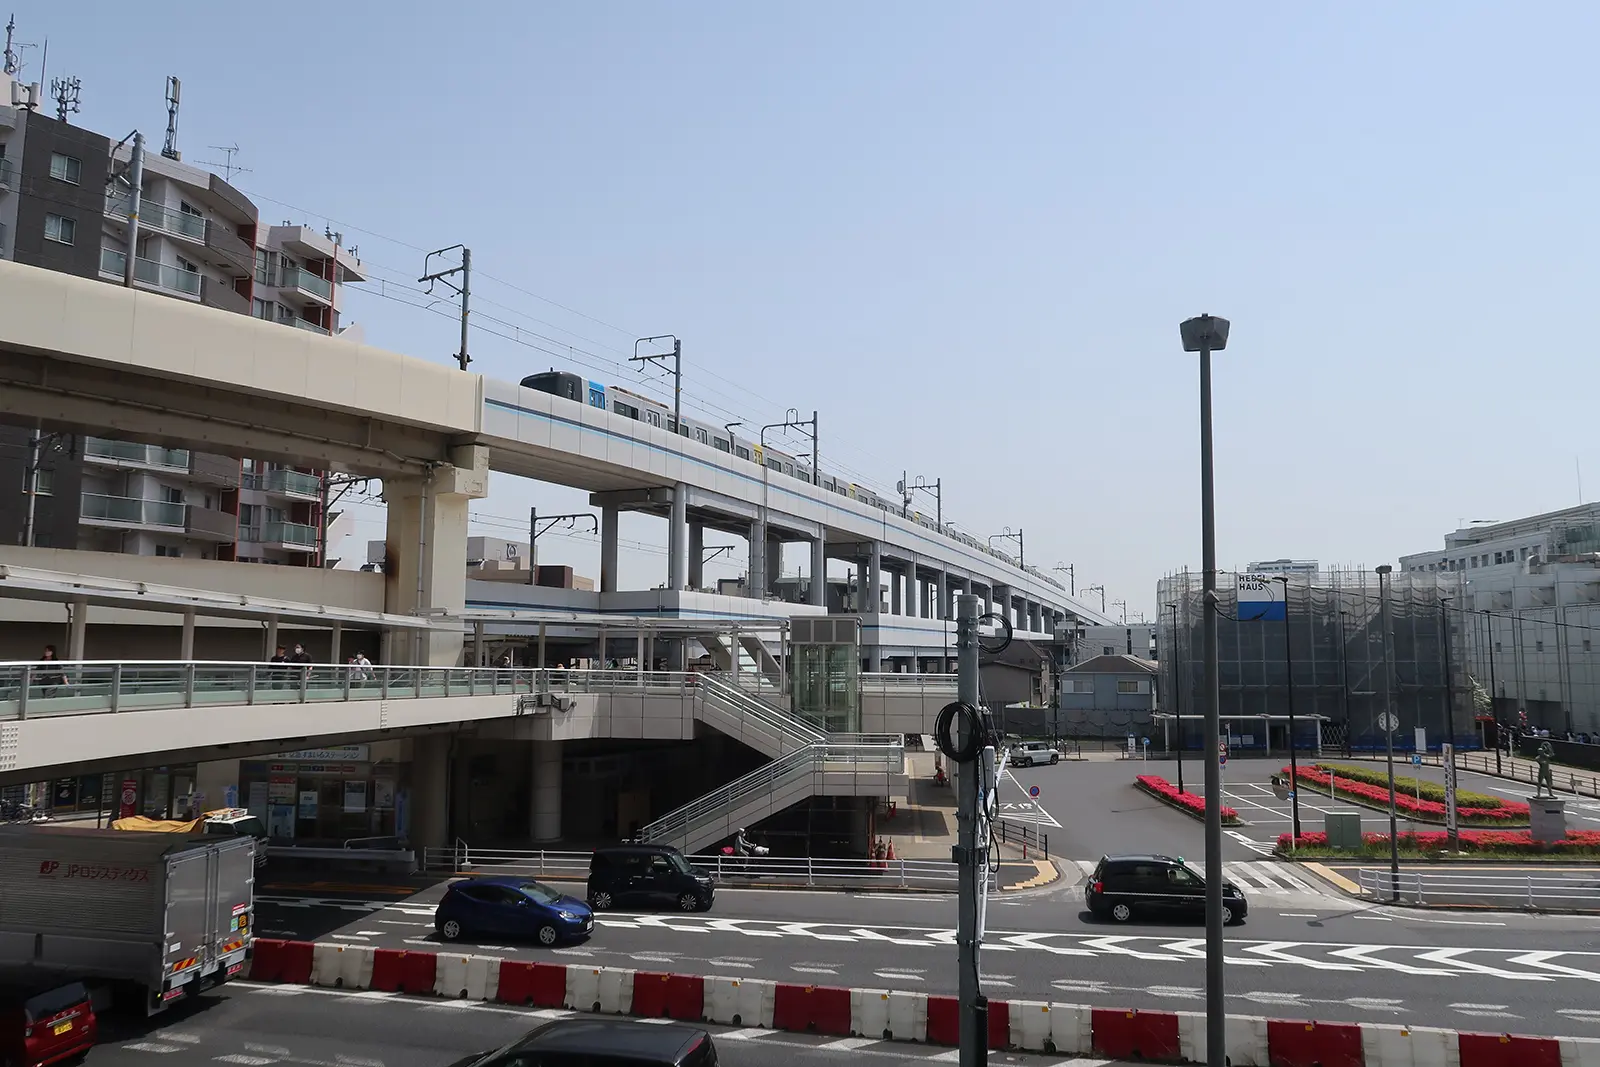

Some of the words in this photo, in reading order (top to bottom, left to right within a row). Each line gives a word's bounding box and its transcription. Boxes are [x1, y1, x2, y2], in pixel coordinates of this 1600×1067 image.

[1239, 583, 1263, 591] HAUS
[1413, 755, 1420, 764] P
[64, 864, 149, 881] JPロジスティクス
